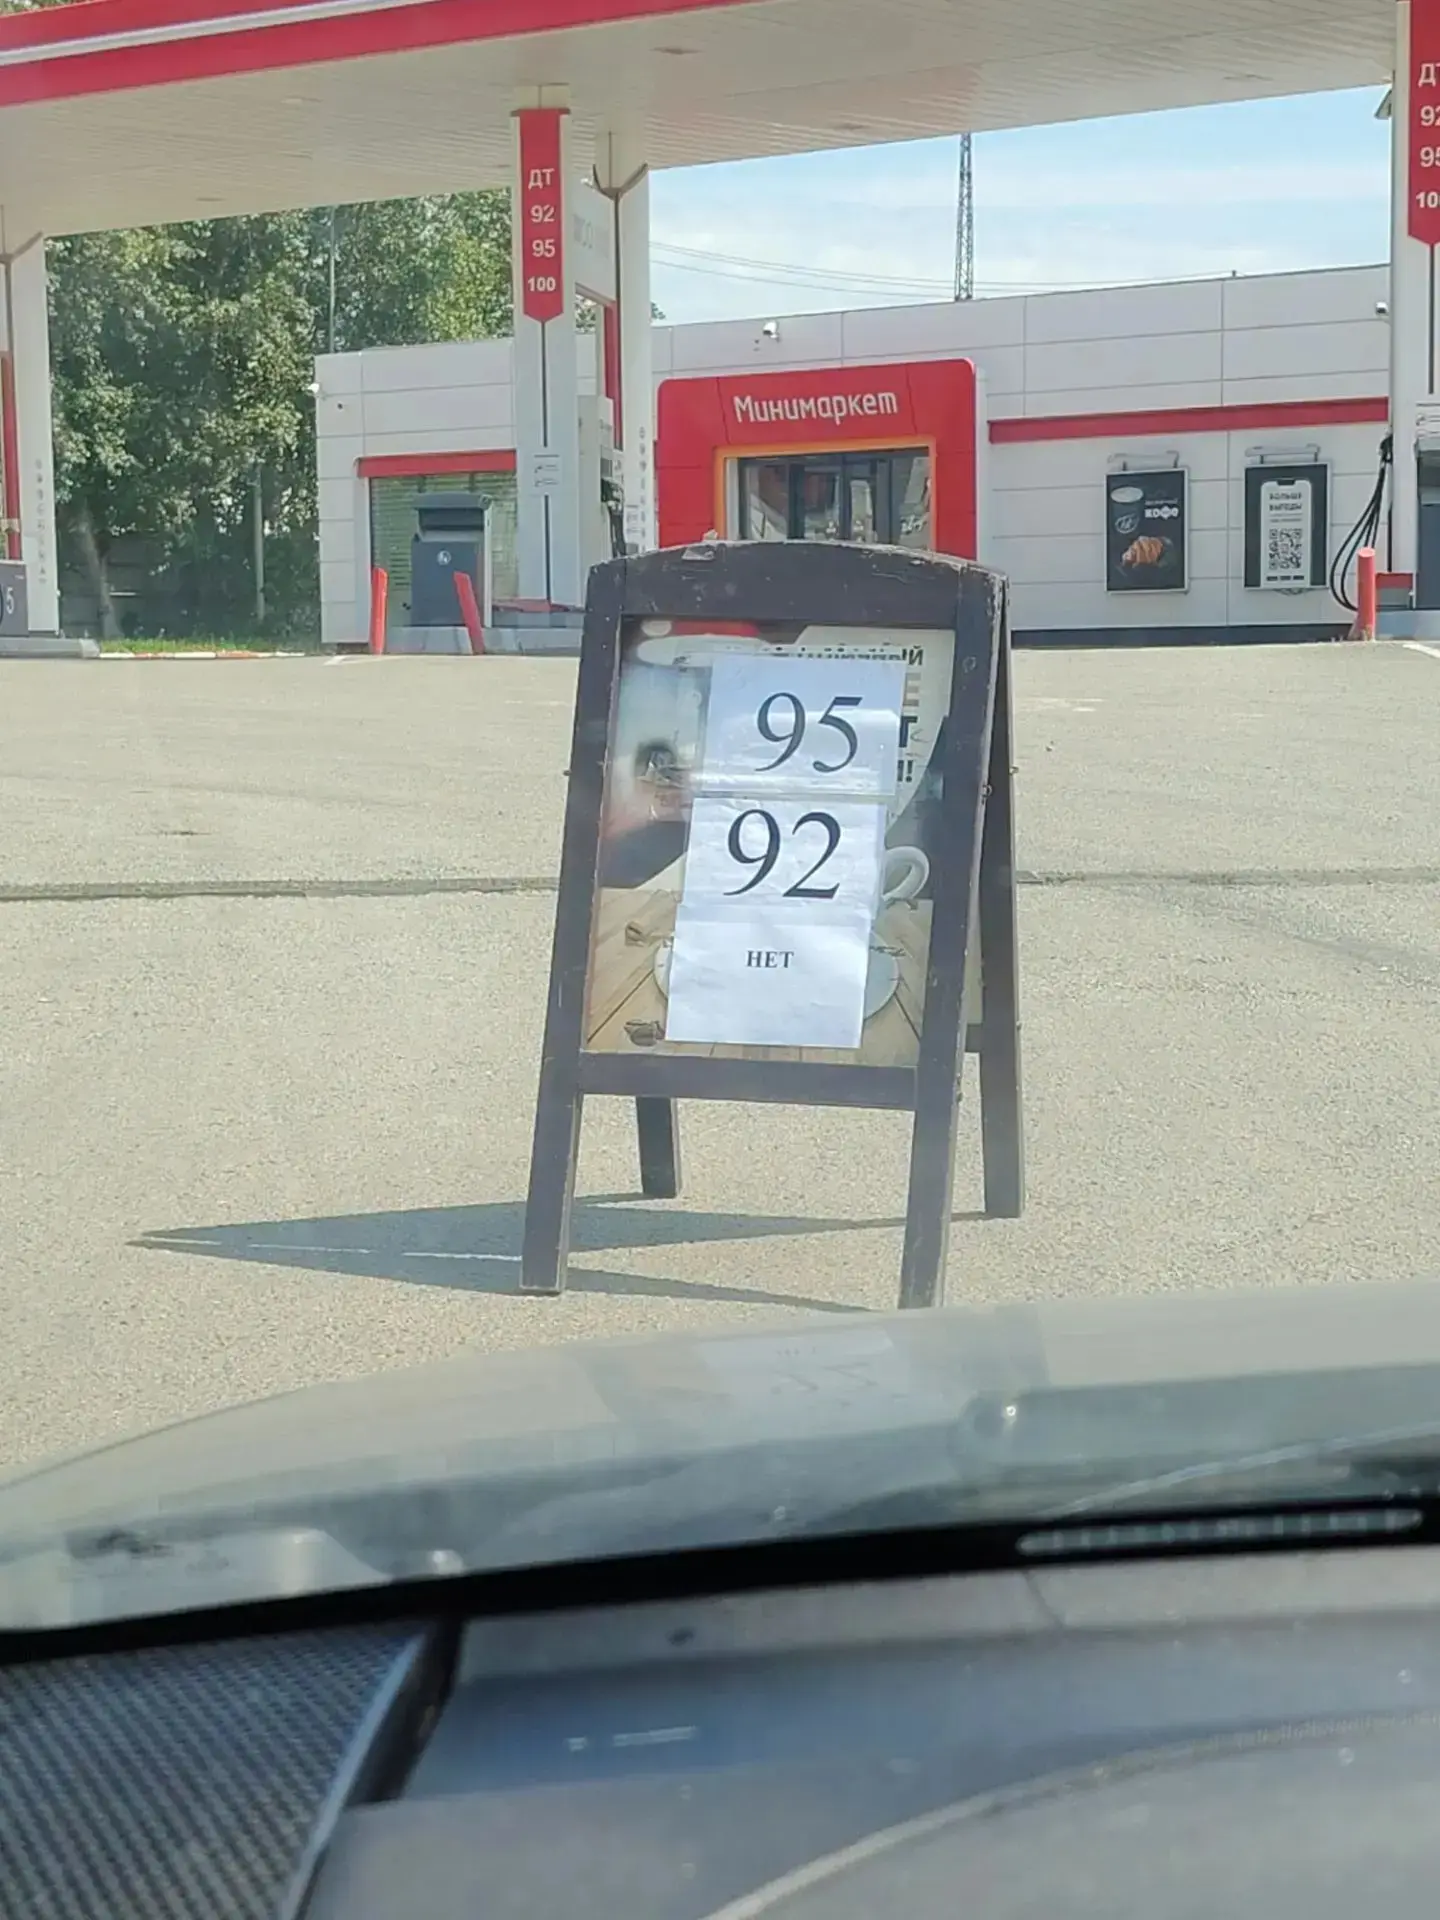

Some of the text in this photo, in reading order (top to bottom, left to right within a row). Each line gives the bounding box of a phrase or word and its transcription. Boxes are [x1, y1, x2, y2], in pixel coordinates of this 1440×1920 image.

[528, 168, 555, 190] ДТ
[1416, 191, 1440, 209] 10
[530, 204, 555, 223] 92
[532, 239, 556, 258] 95
[527, 276, 556, 292] 100
[733, 391, 898, 426] Минимаркет
[5, 587, 15, 615] 5
[754, 692, 863, 773] 95
[723, 809, 841, 900] 92
[746, 950, 795, 969] НЕТ
